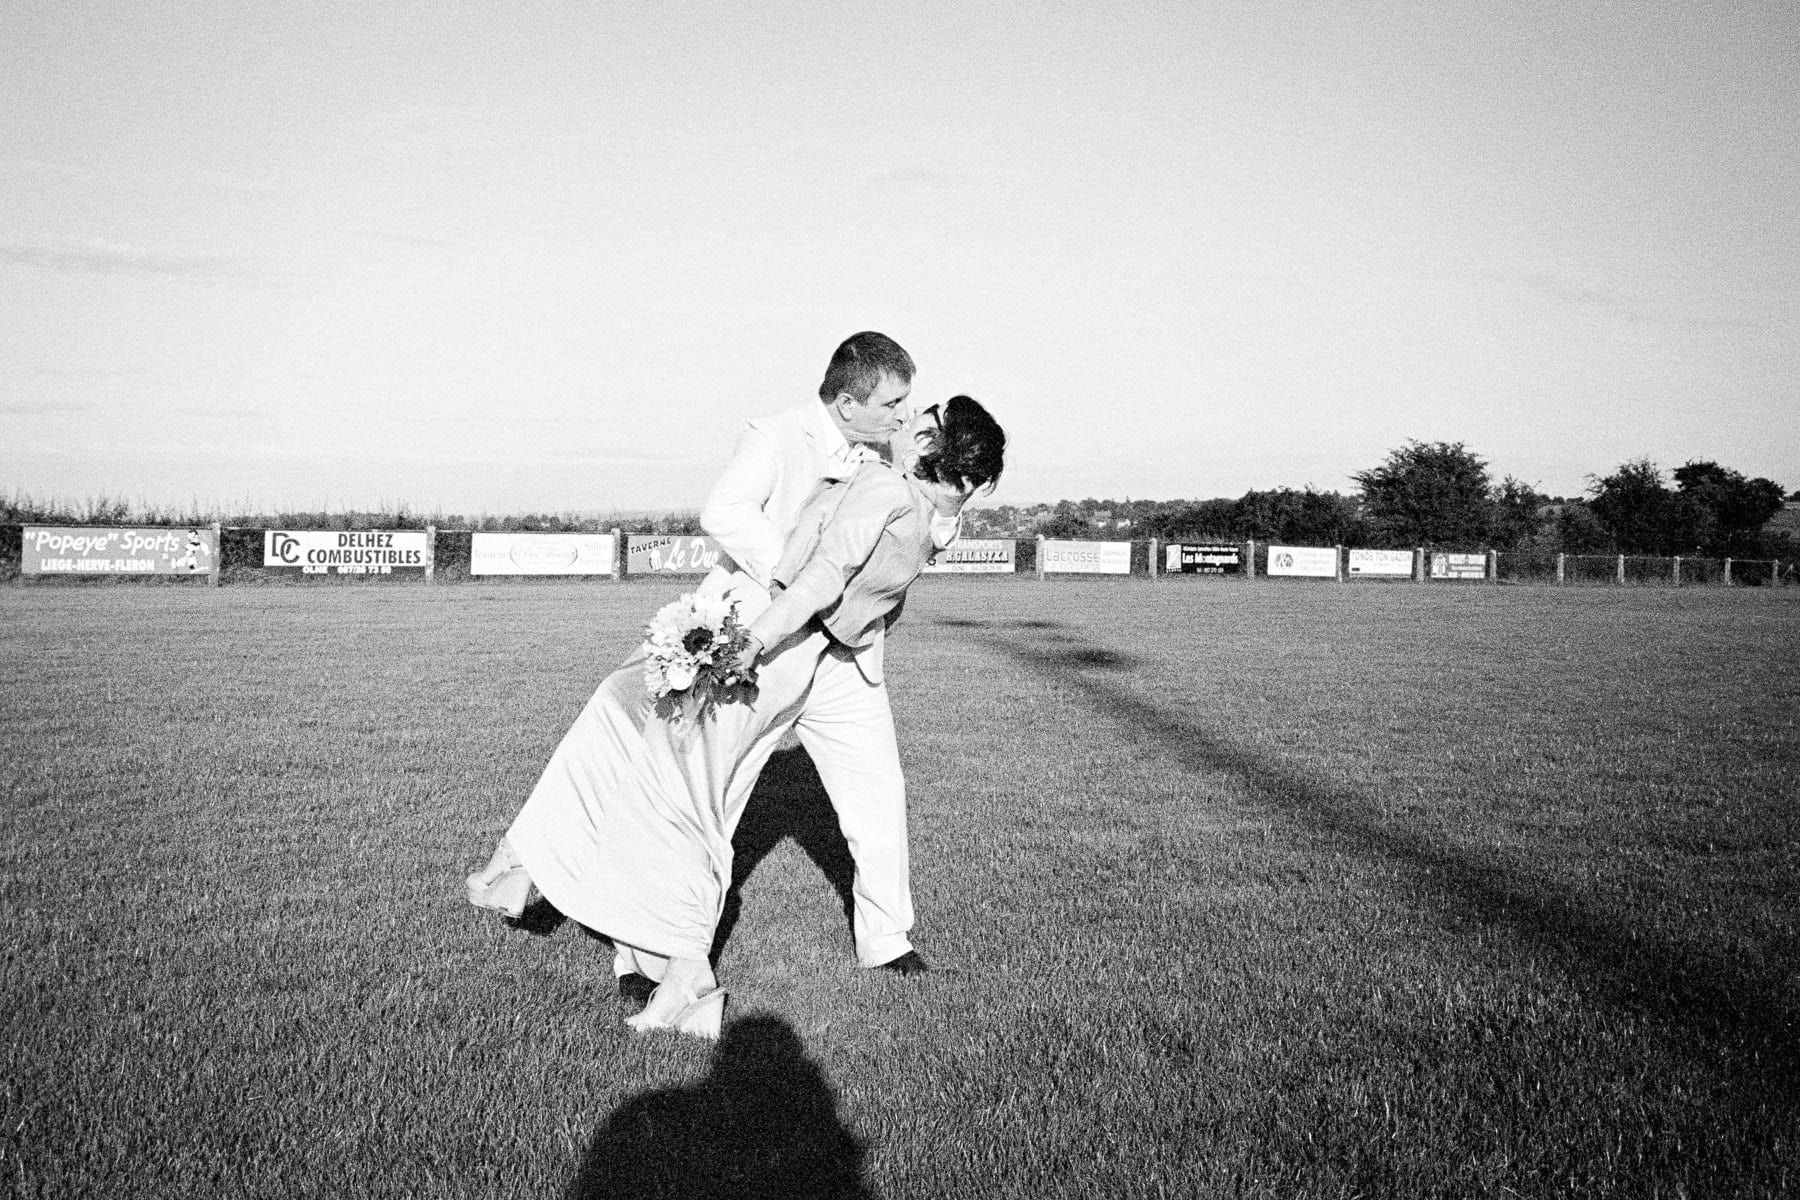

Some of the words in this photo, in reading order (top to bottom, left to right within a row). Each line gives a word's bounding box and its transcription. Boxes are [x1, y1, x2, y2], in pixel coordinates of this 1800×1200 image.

[25, 531, 118, 556] "Popeye"
[120, 531, 180, 555] Sports
[338, 533, 393, 548] DELHEZ
[630, 537, 671, 554] TAVERNE
[307, 549, 421, 564] COMBUSTIBLES
[664, 539, 686, 571] Le
[1046, 547, 1099, 563] Lacrosse
[1182, 552, 1194, 564] Les
